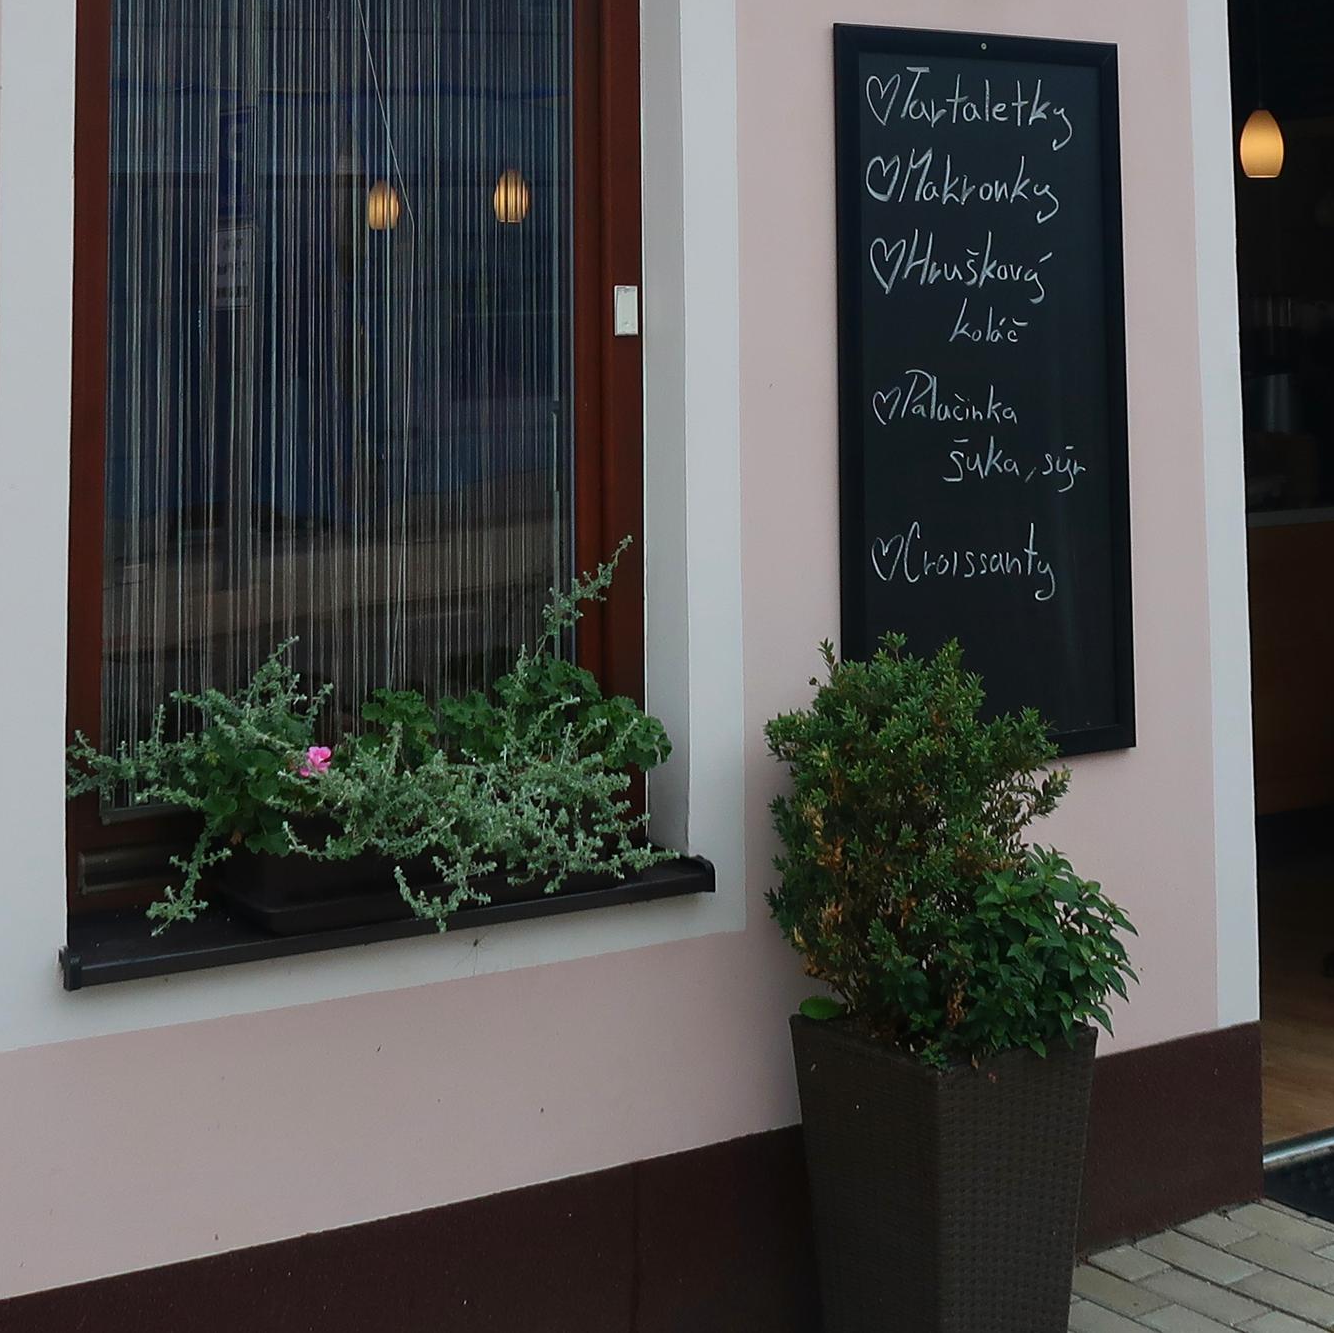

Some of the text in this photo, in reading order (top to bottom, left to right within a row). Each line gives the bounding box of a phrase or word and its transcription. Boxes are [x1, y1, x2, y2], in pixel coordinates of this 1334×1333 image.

[901, 66, 1073, 150] Tartaletky
[899, 147, 1059, 224] Makronky
[903, 521, 1056, 601] Croissanty
